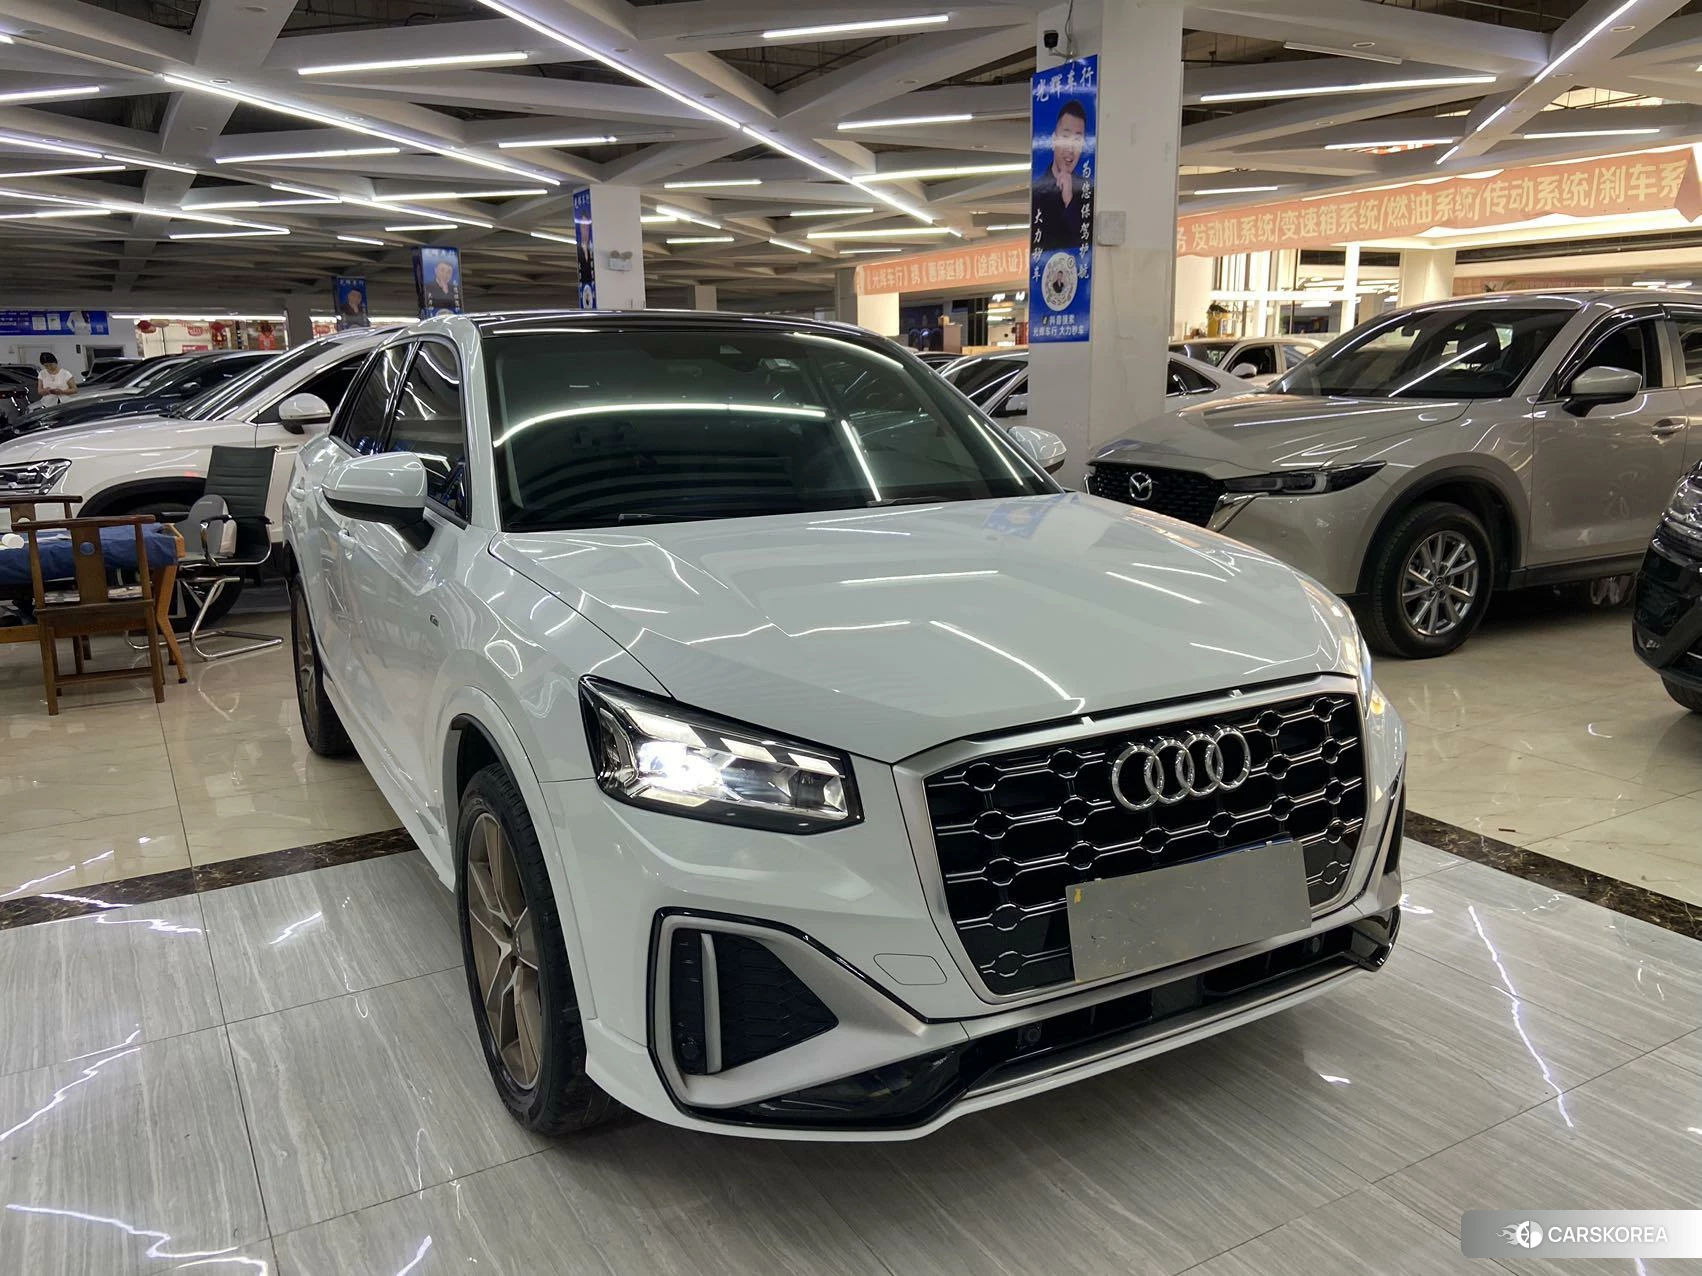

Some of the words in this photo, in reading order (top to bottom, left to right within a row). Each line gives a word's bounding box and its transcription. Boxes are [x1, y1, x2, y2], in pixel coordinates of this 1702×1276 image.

[1077, 159, 1092, 279] 为您保驾护航
